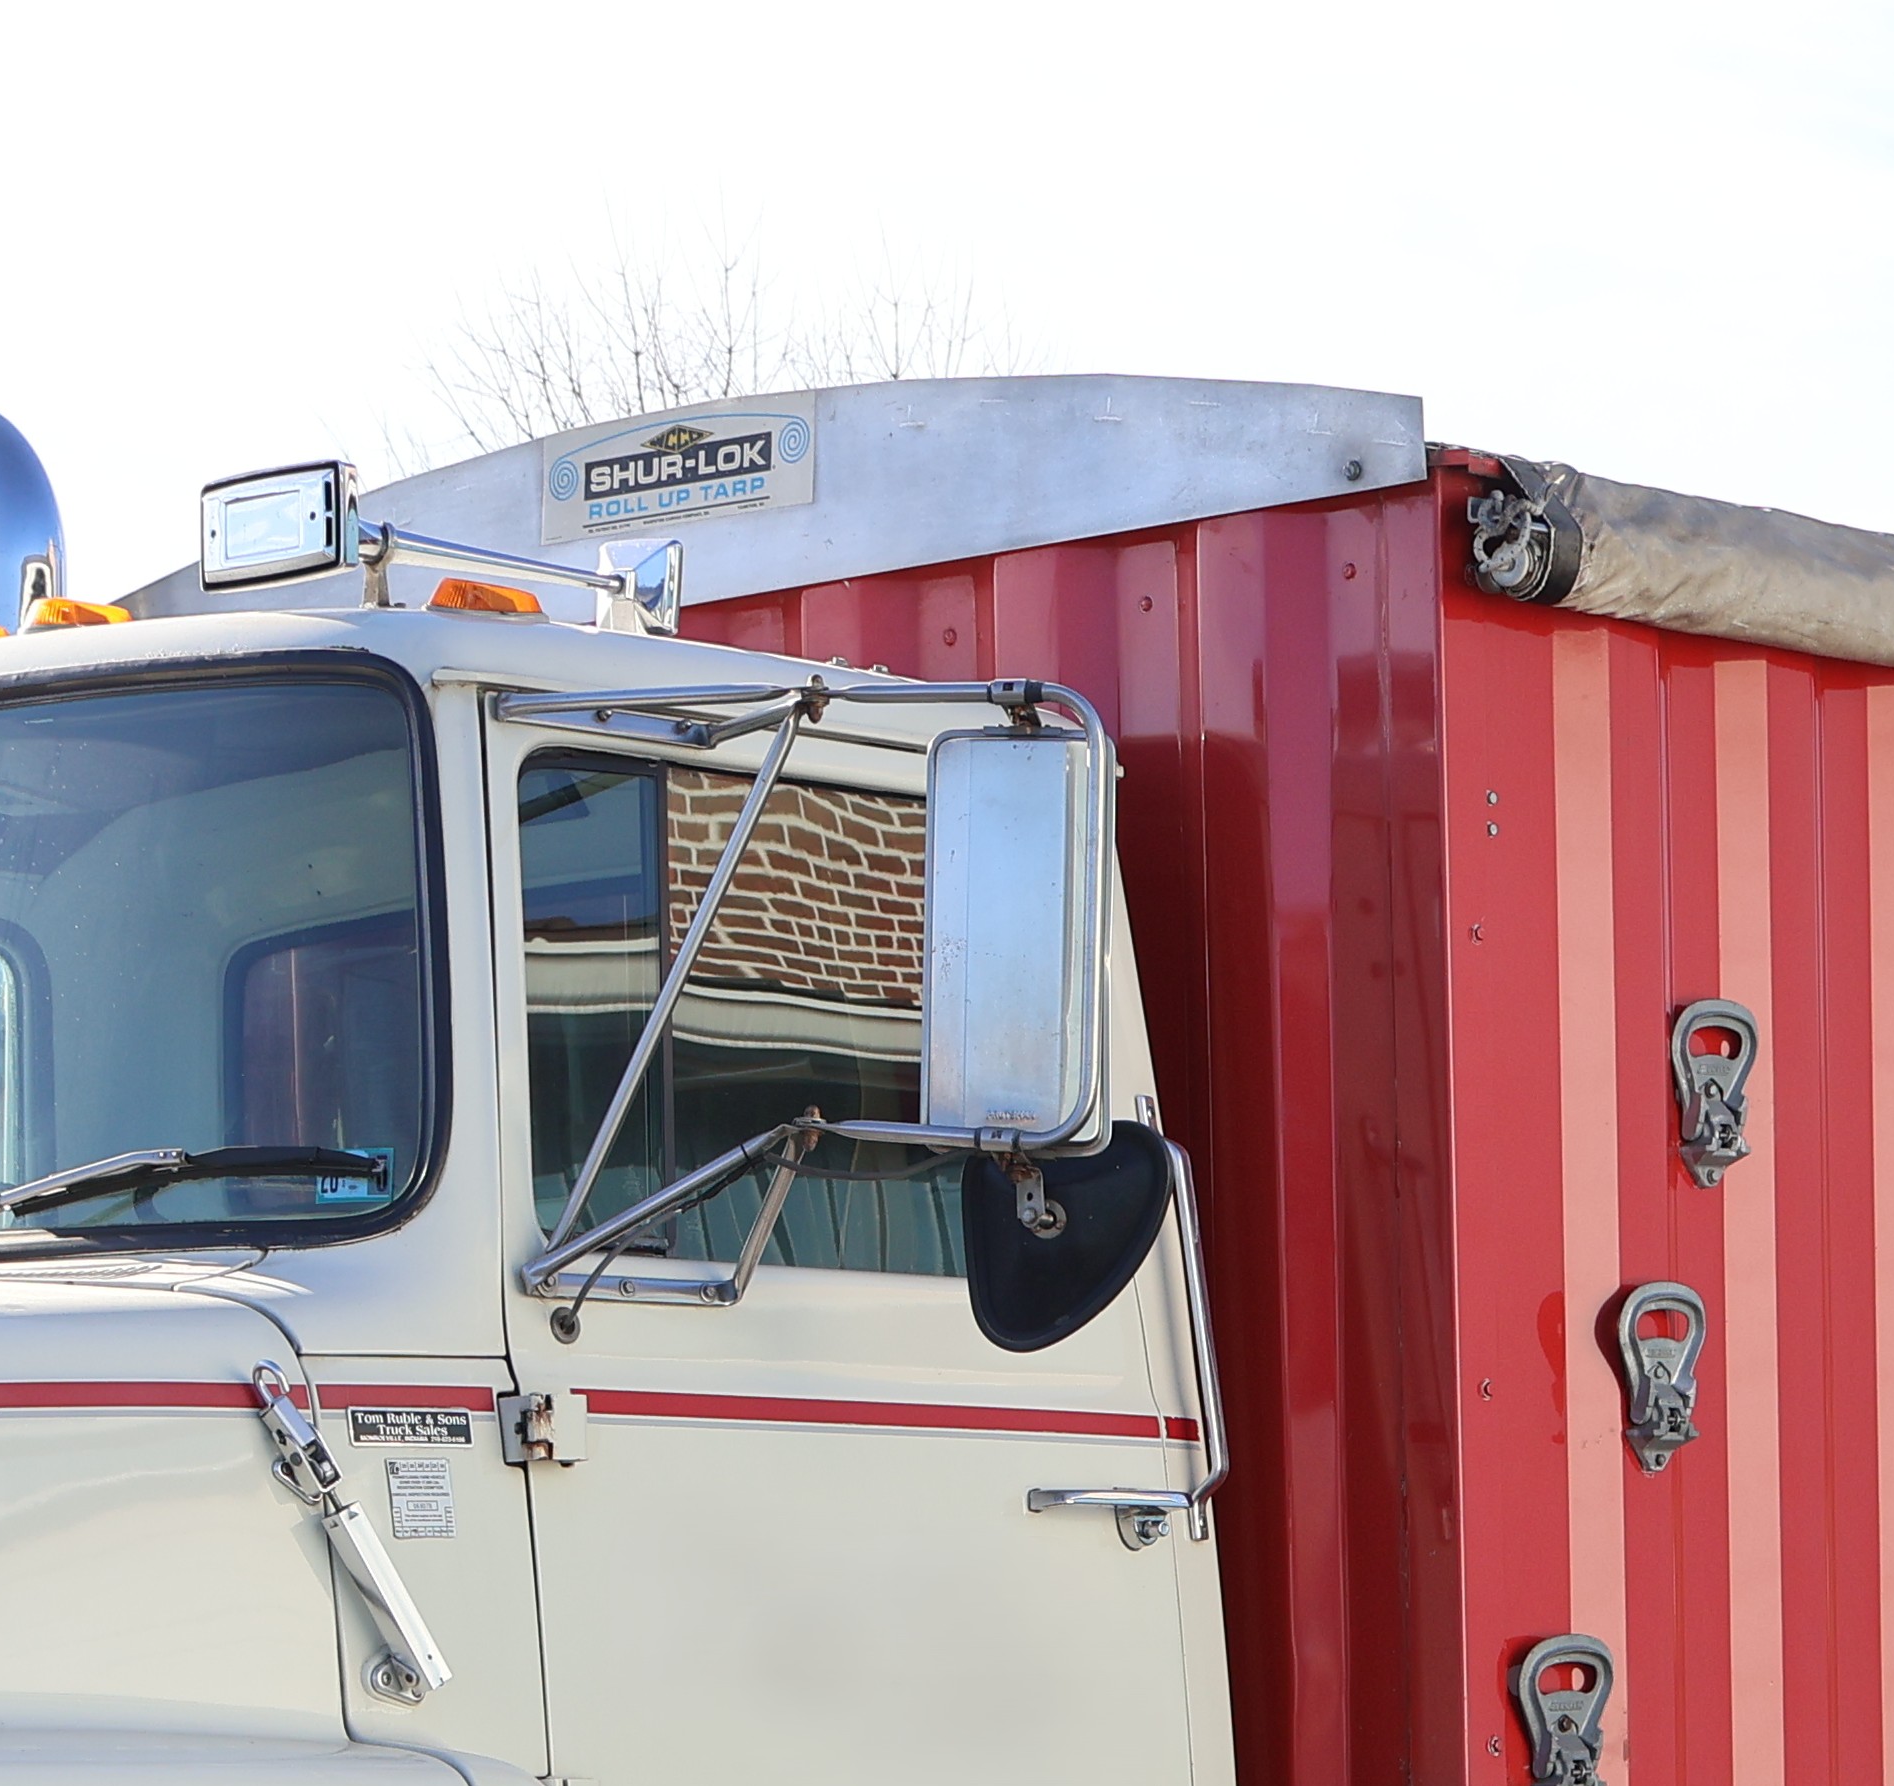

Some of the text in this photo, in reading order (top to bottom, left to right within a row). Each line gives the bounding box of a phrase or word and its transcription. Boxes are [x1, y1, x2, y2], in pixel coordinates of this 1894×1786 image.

[590, 440, 766, 493] SHUR-LOK
[589, 496, 649, 520] ROLL
[658, 488, 690, 508] UP
[699, 477, 765, 500] TARP
[354, 1413, 467, 1425] Tom Ruble & Sons
[377, 1424, 448, 1436] Truck Sales
